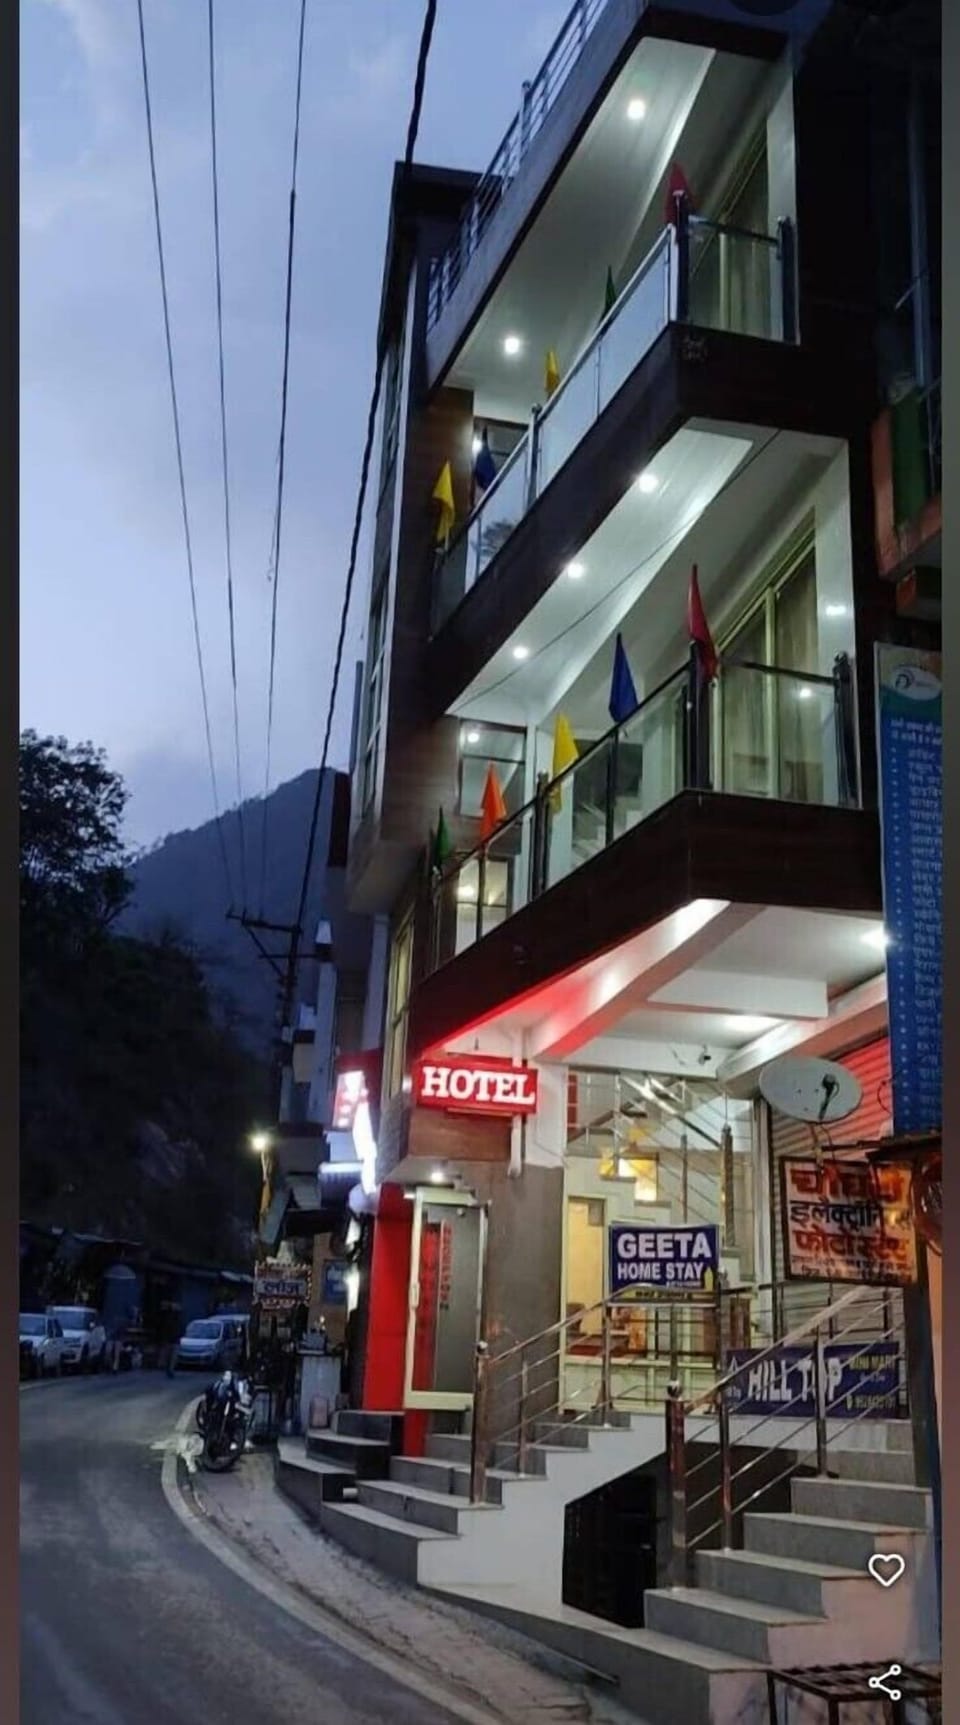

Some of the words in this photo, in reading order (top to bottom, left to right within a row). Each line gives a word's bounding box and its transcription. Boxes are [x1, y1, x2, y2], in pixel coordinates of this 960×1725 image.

[421, 1066, 536, 1105] HOTEL
[617, 1231, 712, 1259] GEETA
[617, 1261, 662, 1281] HOME
[665, 1261, 704, 1281] STAY
[747, 1358, 792, 1402] HILL
[797, 1356, 842, 1403] TP
